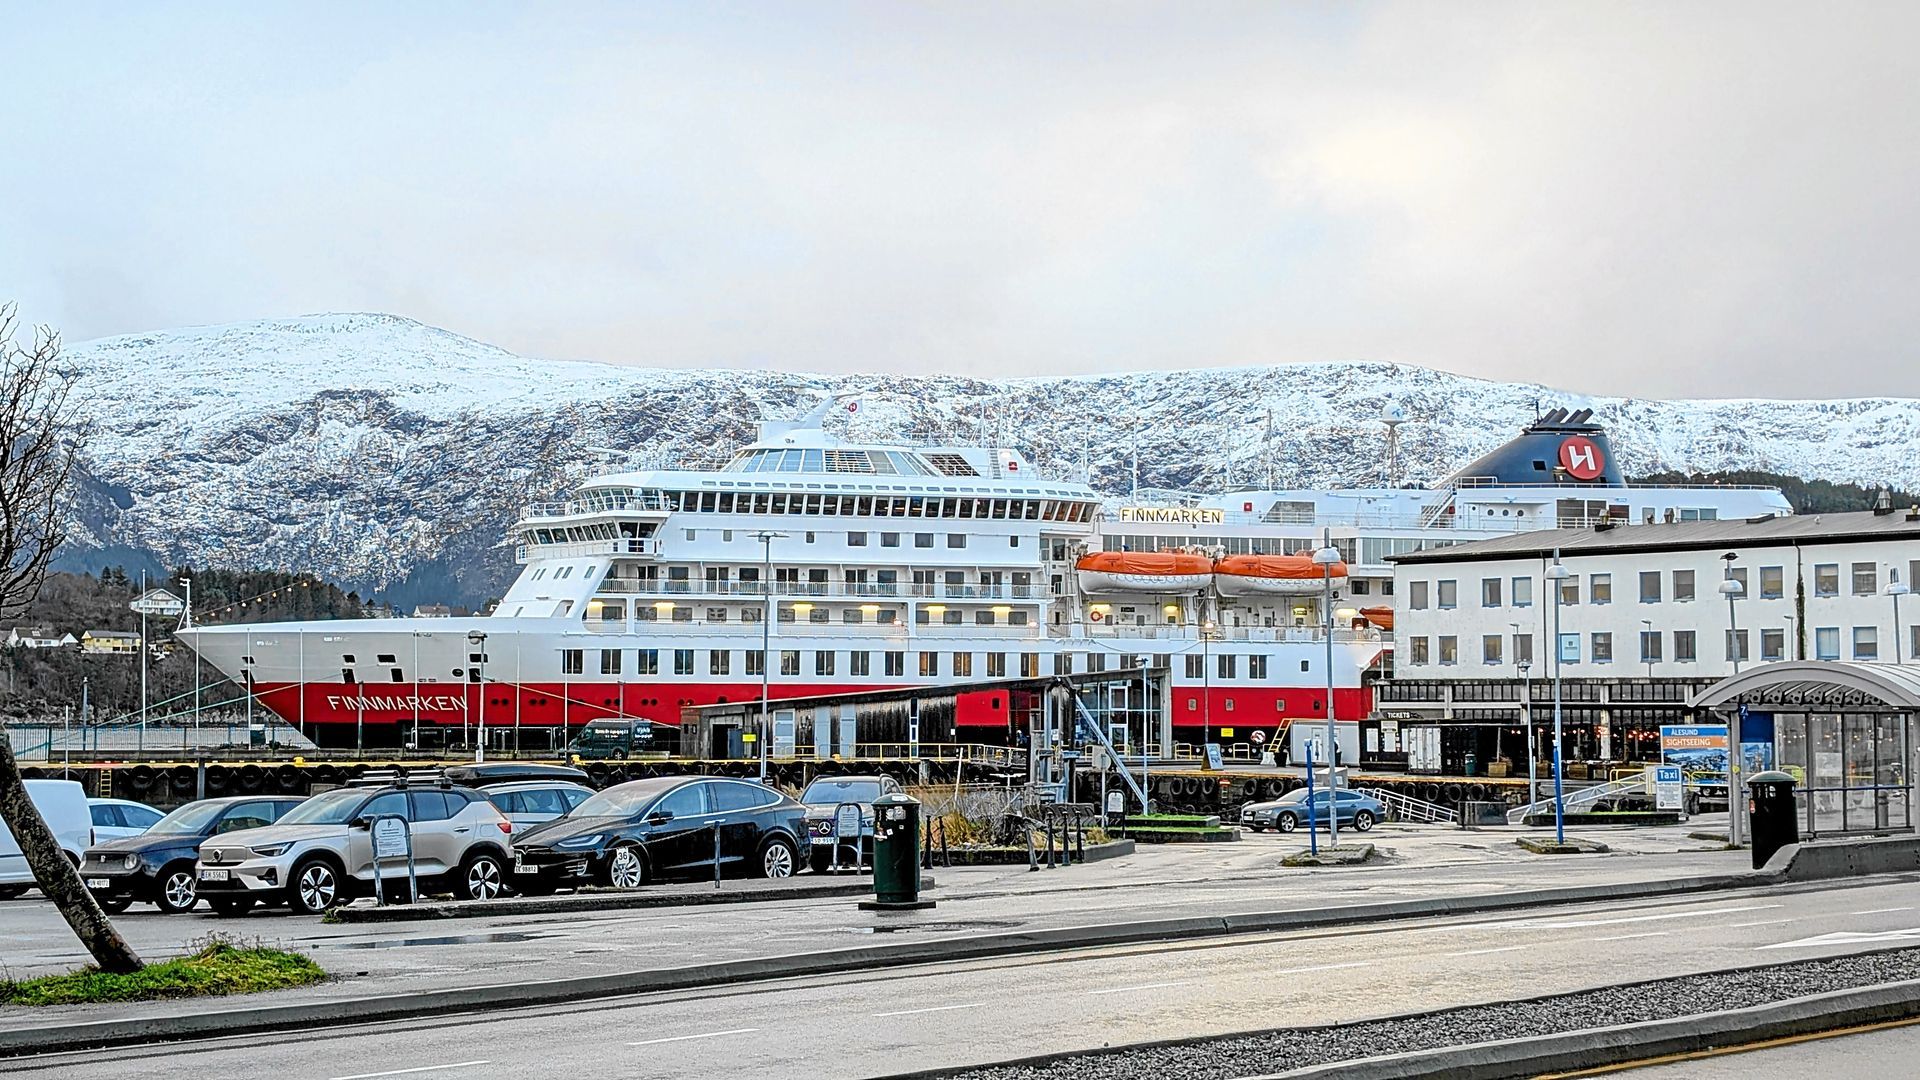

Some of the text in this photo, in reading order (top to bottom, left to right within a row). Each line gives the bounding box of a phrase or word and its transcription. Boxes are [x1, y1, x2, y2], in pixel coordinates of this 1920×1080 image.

[1121, 509, 1220, 523] FINNMARKEN
[327, 695, 468, 711] FINNMARKEN
[1387, 711, 1411, 719] TICKETS
[1671, 728, 1699, 736] ÅLESUND
[1666, 738, 1711, 746] SIGHTSEEING
[1658, 770, 1678, 780] Taxi
[618, 851, 628, 861] 36
